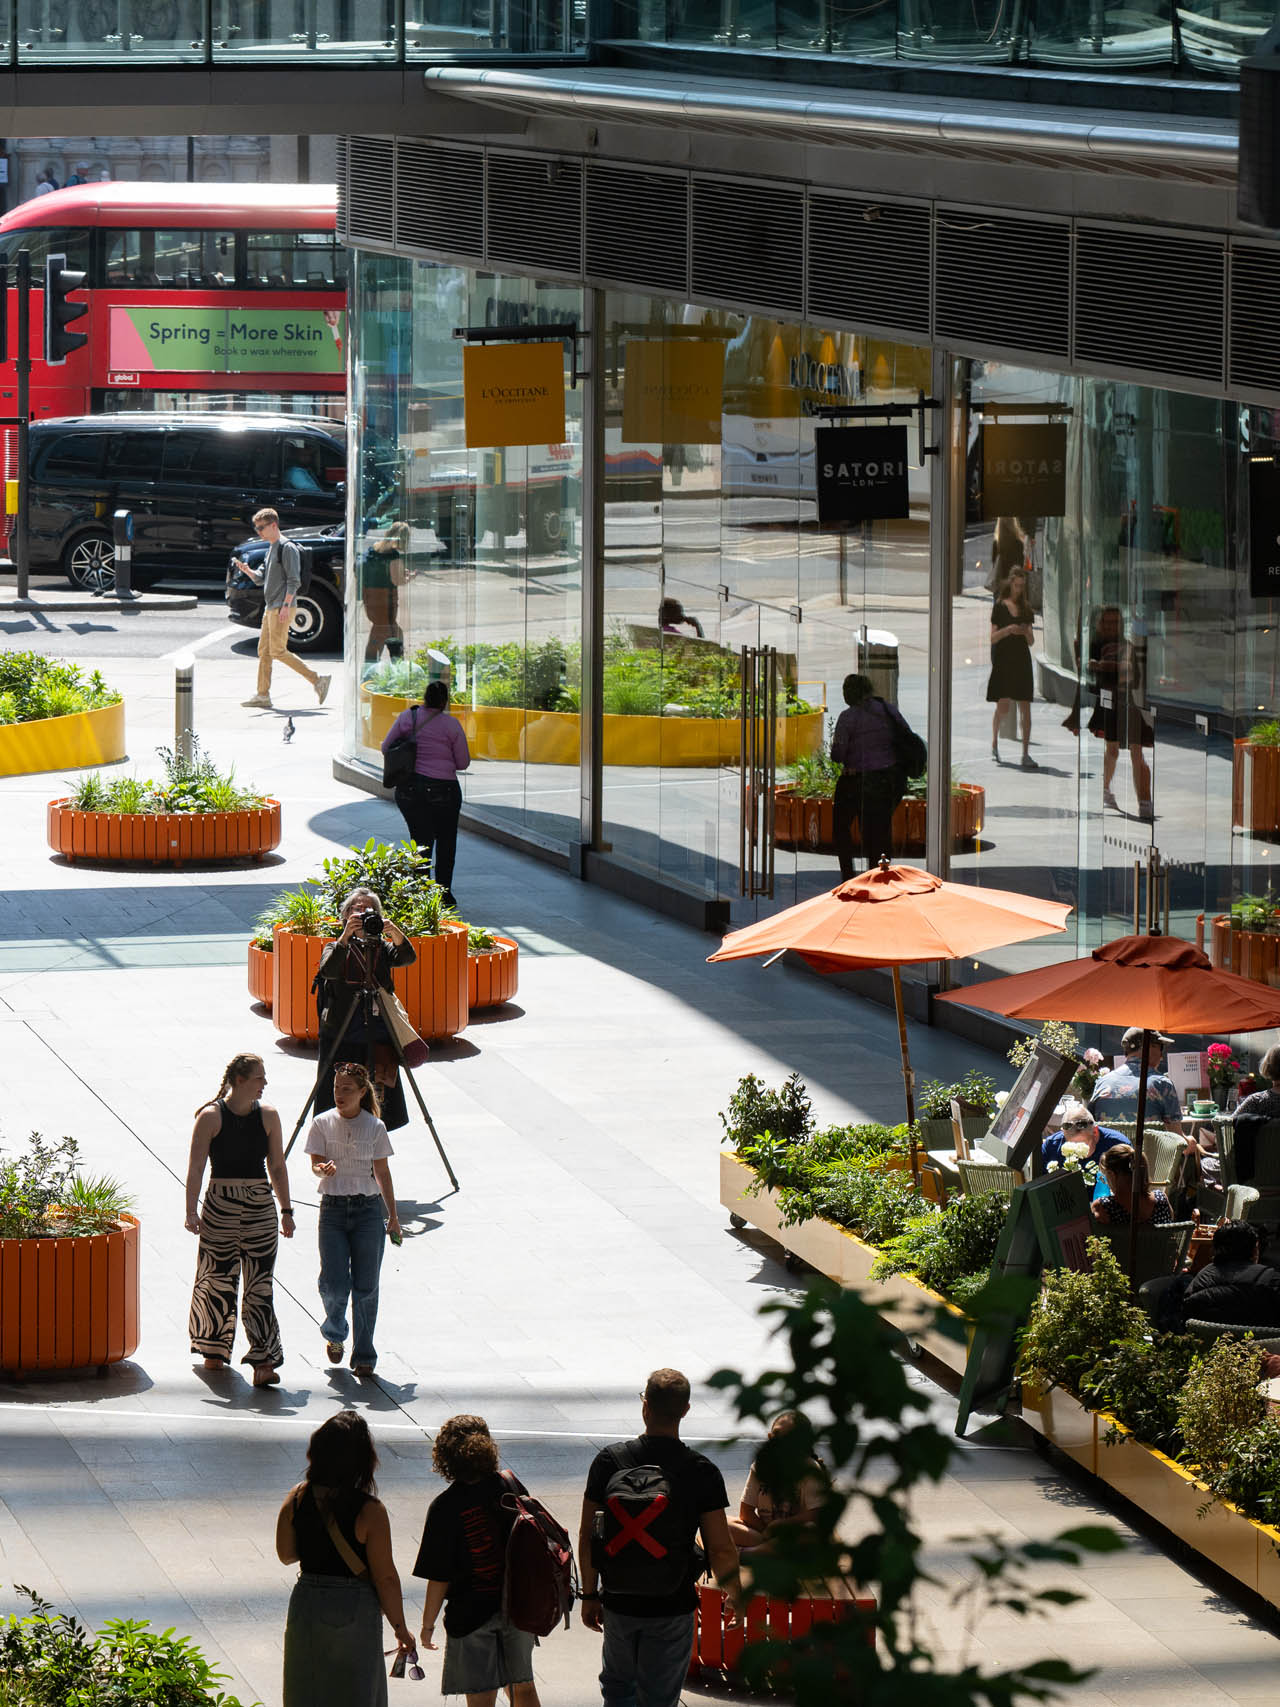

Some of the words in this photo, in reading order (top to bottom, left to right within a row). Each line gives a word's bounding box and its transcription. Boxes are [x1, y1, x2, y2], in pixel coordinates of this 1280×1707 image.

[149, 322, 210, 344] Spring
[230, 323, 279, 341] More
[283, 323, 323, 341] Skin
[214, 346, 240, 356] Book
[250, 348, 270, 357] wax
[272, 346, 318, 357] wherever
[113, 374, 134, 382] global
[481, 386, 549, 399] L'OCCITANE
[823, 461, 904, 478] SATORI
[852, 479, 874, 487] LDN
[1268, 566, 1280, 576] RE
